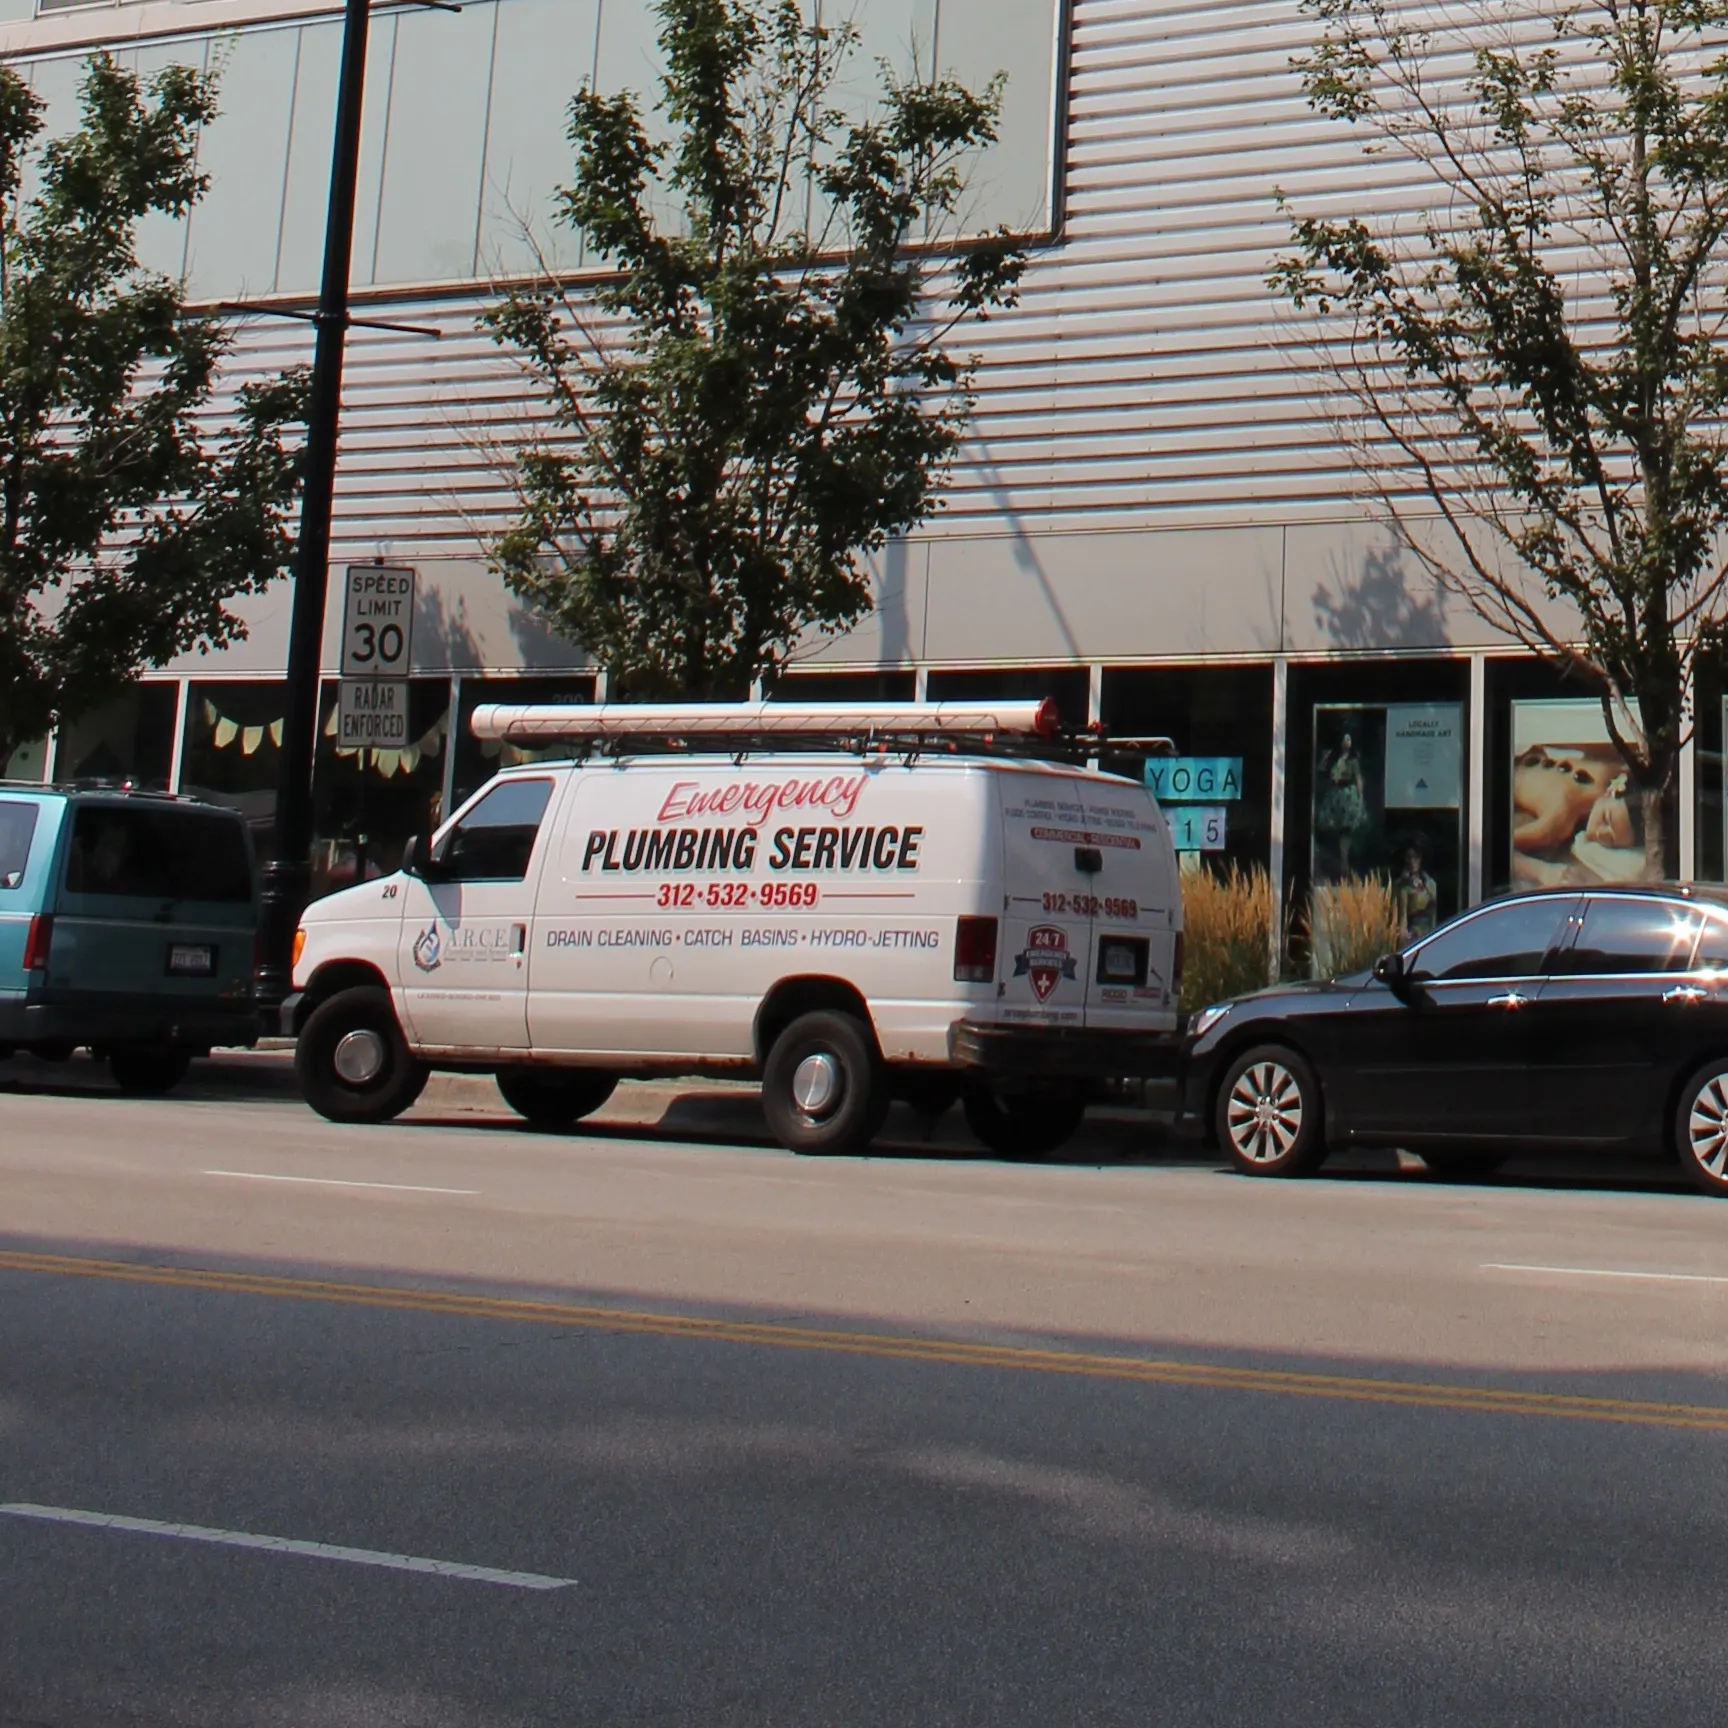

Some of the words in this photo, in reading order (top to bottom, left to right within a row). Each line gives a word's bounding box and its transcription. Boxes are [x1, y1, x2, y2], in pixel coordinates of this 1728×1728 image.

[352, 576, 410, 594] SPEED
[357, 600, 402, 616] LIMIT
[352, 623, 404, 663] 30
[354, 686, 394, 712] RADAR
[343, 714, 404, 737] ENFORCED
[1408, 720, 1439, 728] LOCALLY
[1437, 729, 1451, 737] ART
[1150, 768, 1239, 793] YOGA
[657, 775, 869, 827] Emergency
[582, 827, 758, 872] PLUMBING
[769, 826, 923, 870] SERVICE
[382, 885, 398, 899] 20
[547, 930, 592, 946] DRAIN
[598, 929, 673, 946] CLEANING
[684, 930, 733, 946] CATCH
[741, 929, 798, 946] BASINS
[810, 929, 939, 948] HYDRO-JETTING
